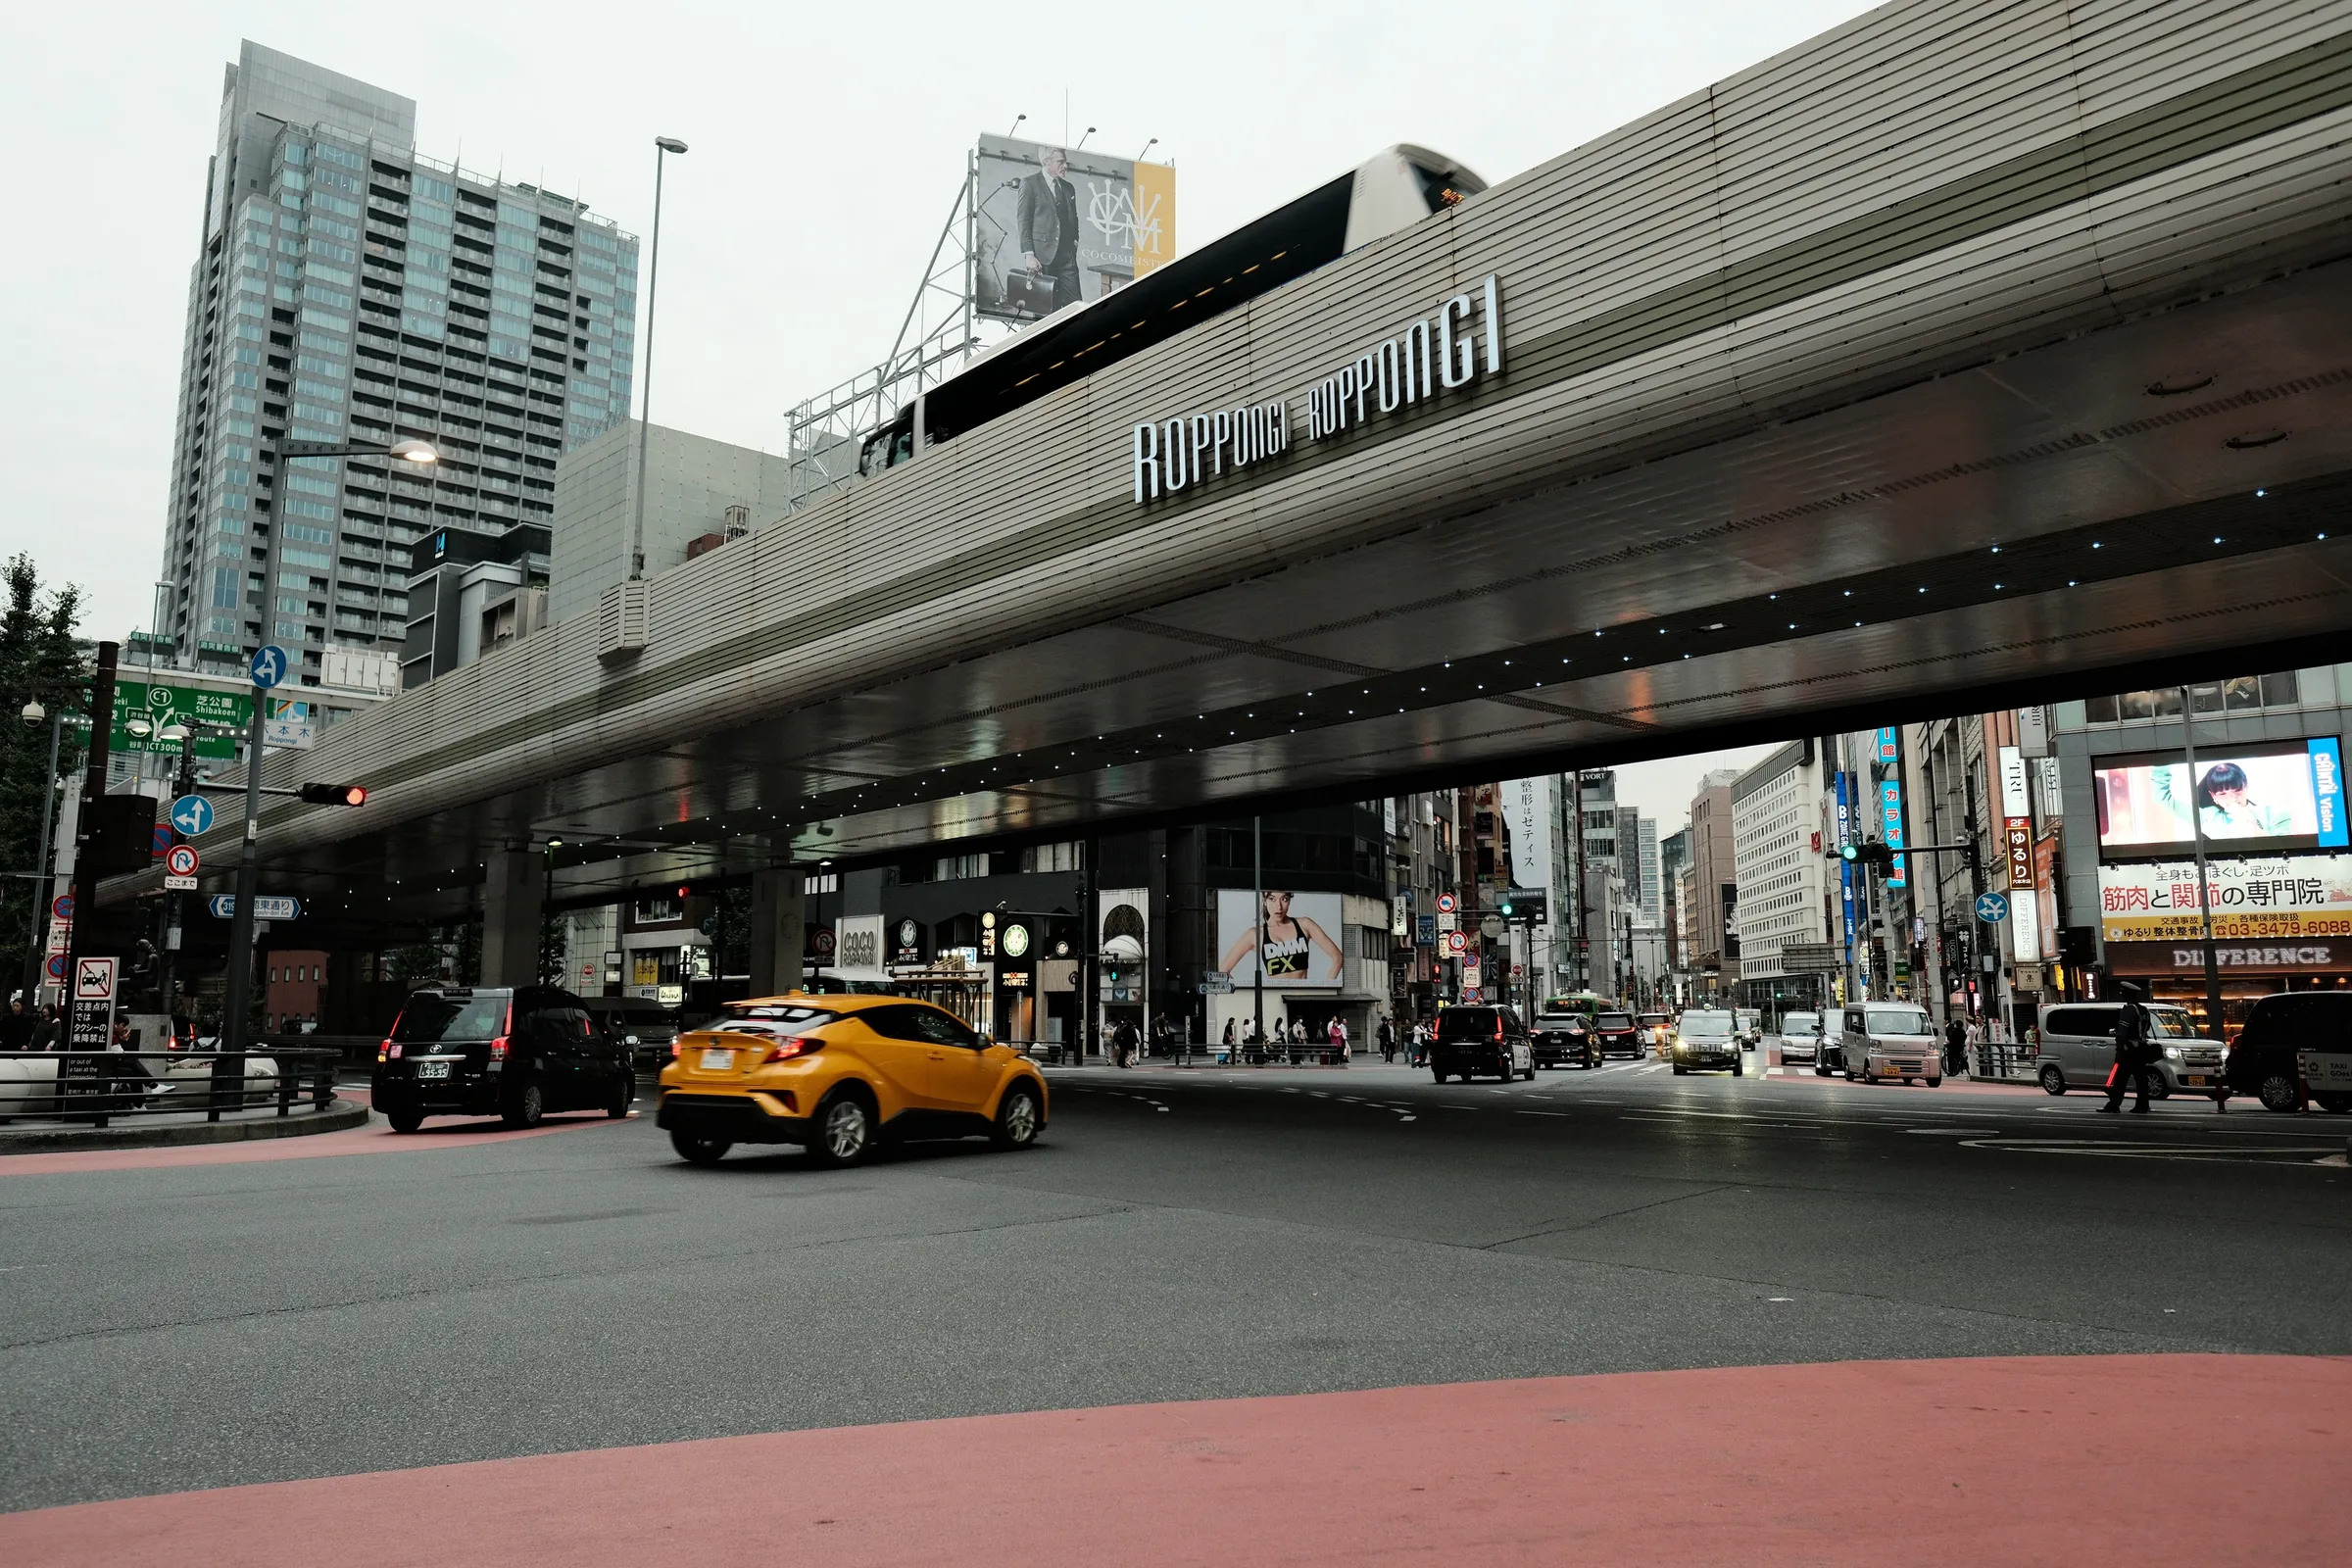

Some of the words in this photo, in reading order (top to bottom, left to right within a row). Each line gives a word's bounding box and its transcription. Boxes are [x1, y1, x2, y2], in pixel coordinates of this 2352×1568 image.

[1081, 248, 1164, 269] COCOMEISTE
[1133, 400, 1289, 505] ROPPONGI
[1308, 272, 1505, 441] ROPPONGI
[153, 691, 168, 703] C1
[197, 695, 232, 709] 芝公園
[196, 706, 236, 716] Shibakoen
[268, 735, 298, 745] Roppongi
[2010, 818, 2025, 827] 2F
[2320, 796, 2333, 833] Vision
[2011, 831, 2027, 878] ゆるり
[167, 878, 196, 888] ここまで
[2103, 877, 2325, 911] 筋肉と関節の専門院
[2019, 897, 2032, 956] DIFFERENCE
[2229, 920, 2351, 937] 03-3479-6088
[844, 931, 875, 953] COCO
[1264, 937, 1308, 959] DMM
[2173, 946, 2331, 967] DIFERENCE
[1267, 956, 1296, 976] FX
[75, 1002, 110, 1011] 交差点内
[74, 1023, 108, 1032] タクシーの
[73, 1033, 106, 1043] 乗降禁止
